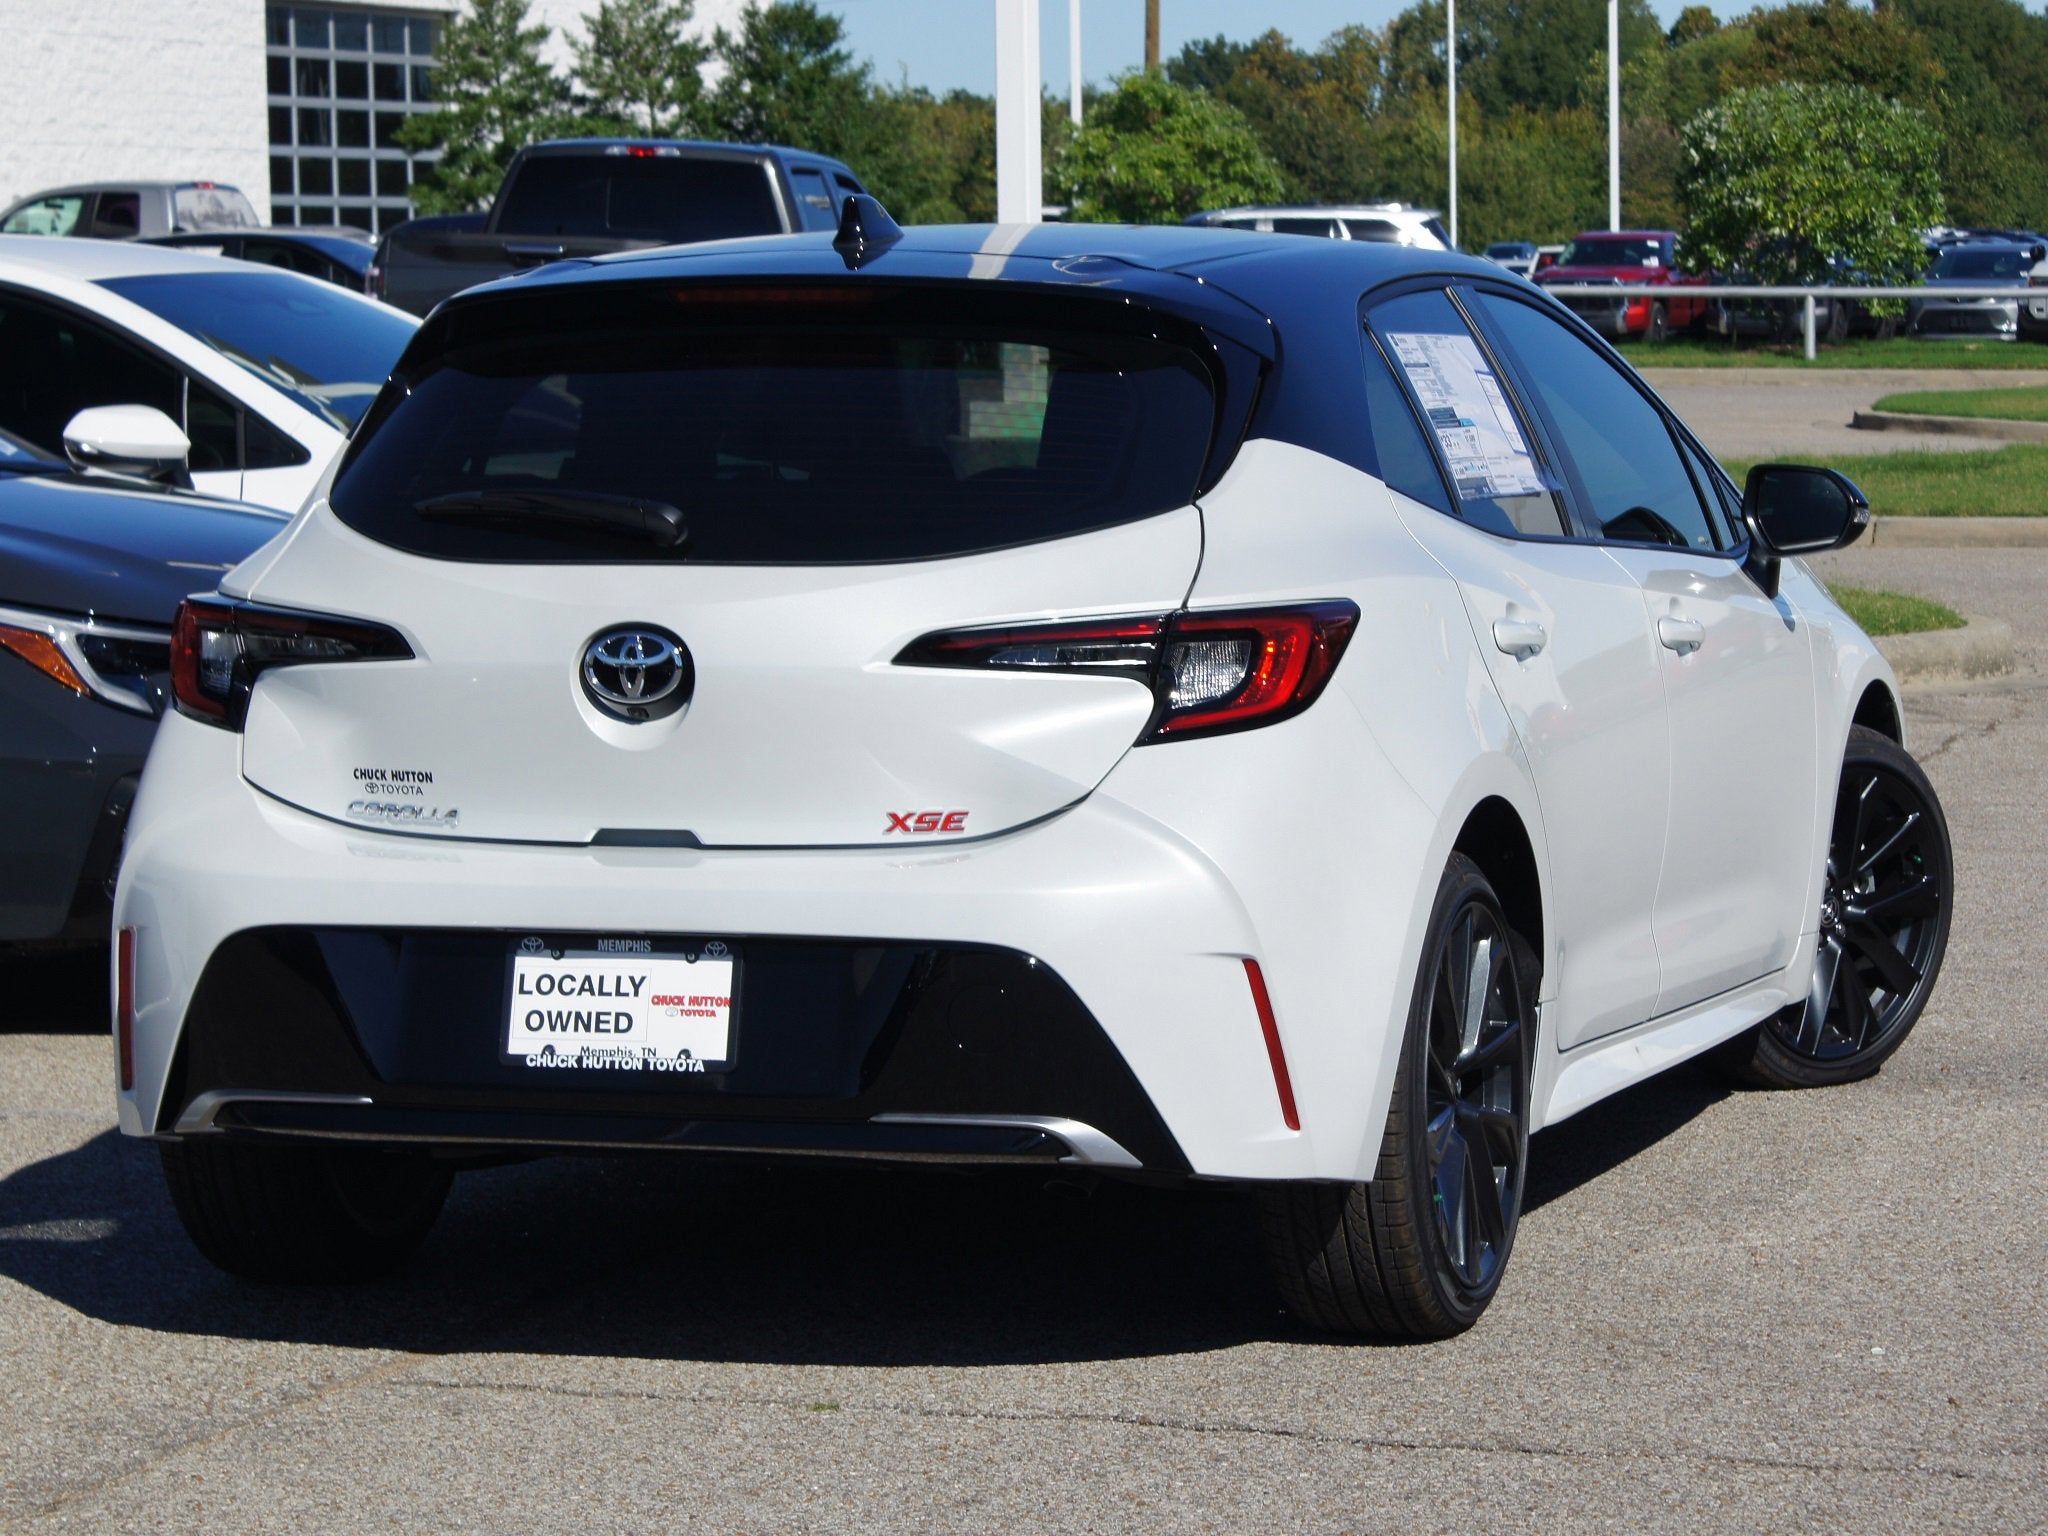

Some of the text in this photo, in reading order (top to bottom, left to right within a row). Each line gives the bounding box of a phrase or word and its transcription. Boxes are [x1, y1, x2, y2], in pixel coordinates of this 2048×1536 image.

[353, 768, 434, 783] CHUCK HUTTON
[381, 784, 424, 795] TOYOTA
[347, 800, 459, 825] COROLLA
[882, 811, 969, 834] XSE
[598, 939, 652, 953] MEMPHIS
[518, 973, 647, 998] LOCALLY
[651, 995, 732, 1007] CHUCK HUTTON
[680, 1009, 717, 1017] TOYOTA
[524, 1009, 634, 1034] OWNED
[580, 1045, 657, 1060] Memphis, TN
[526, 1054, 705, 1073] CHUCK HUTTON TOYOTA
